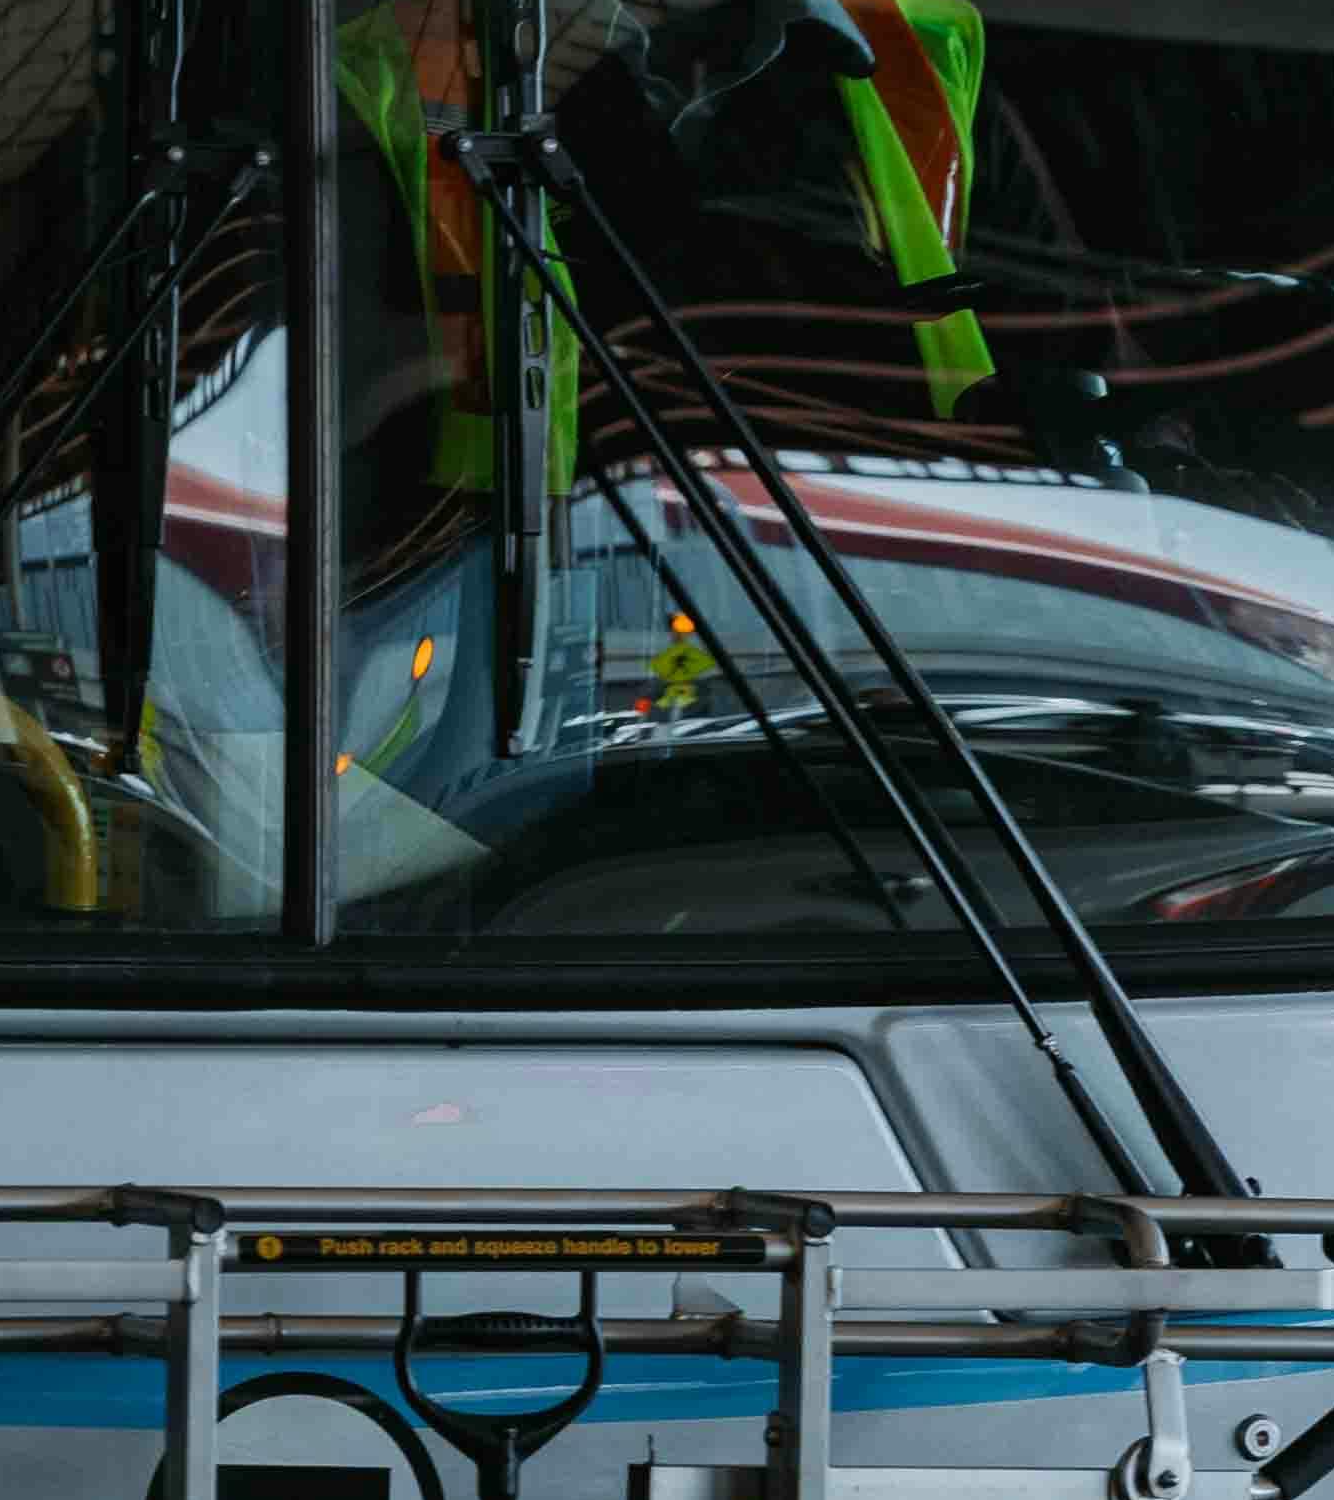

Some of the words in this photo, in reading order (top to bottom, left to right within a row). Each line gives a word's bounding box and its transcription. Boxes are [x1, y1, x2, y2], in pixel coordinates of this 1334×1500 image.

[320, 1238, 373, 1256] Push
[378, 1238, 424, 1256] rack
[429, 1238, 468, 1256] and
[474, 1240, 558, 1261] squeeze
[562, 1237, 634, 1256] handle
[636, 1238, 660, 1256] to
[662, 1238, 721, 1256] lower
